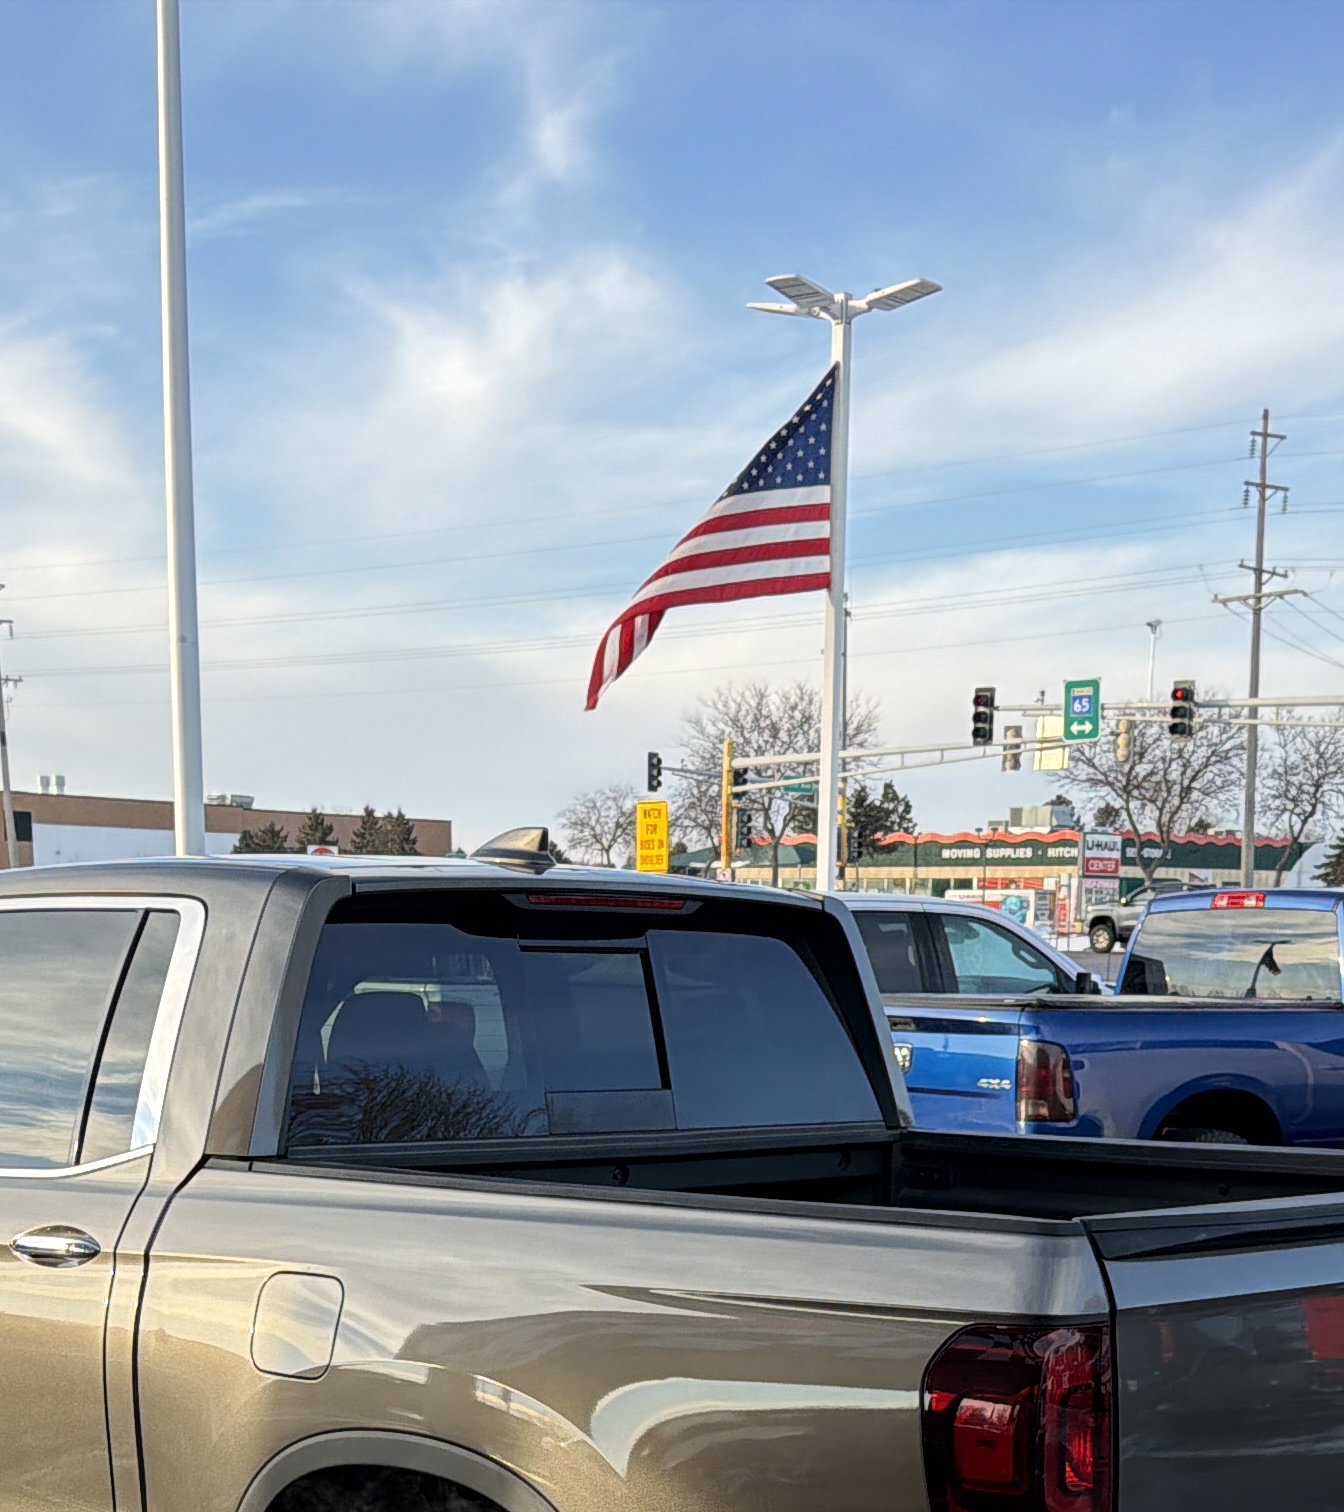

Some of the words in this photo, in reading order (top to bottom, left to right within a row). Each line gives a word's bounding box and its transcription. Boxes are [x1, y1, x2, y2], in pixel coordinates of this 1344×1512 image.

[1072, 697, 1090, 713] 65
[942, 848, 981, 859] MOVING
[986, 847, 1033, 858] SUPPLIES
[1086, 840, 1121, 853] U-HAUL
